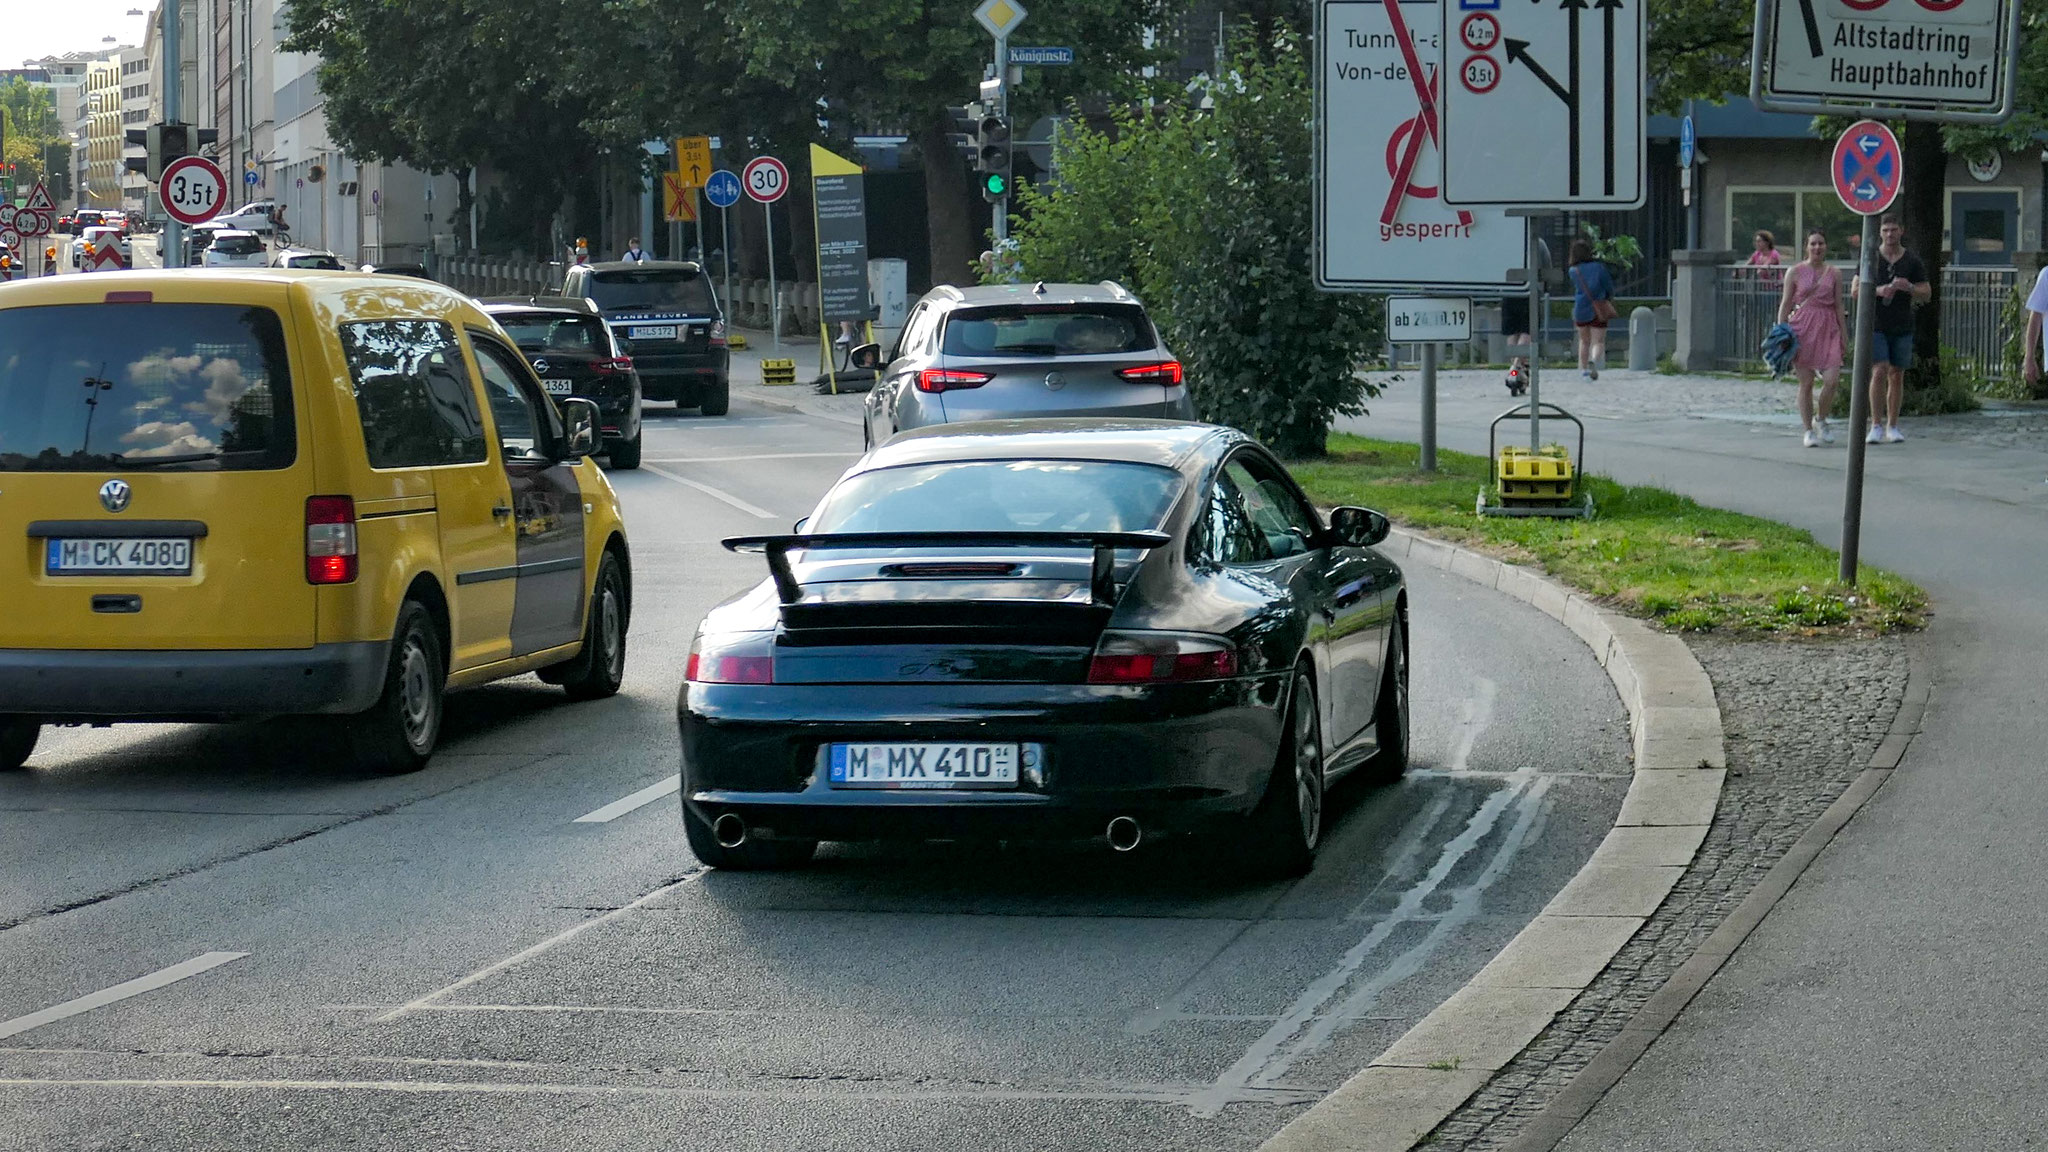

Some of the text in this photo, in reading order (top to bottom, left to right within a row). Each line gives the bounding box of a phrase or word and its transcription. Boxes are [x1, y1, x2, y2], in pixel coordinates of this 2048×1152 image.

[1833, 22, 1970, 60] Altstadtring
[1010, 49, 1070, 64] Königinstr.
[1830, 57, 1988, 91] Hauptbahnhof
[753, 169, 778, 190] 30
[1380, 222, 1471, 242] gesperrt
[1395, 312, 1410, 327] ab
[64, 542, 187, 566] M CK 4080
[850, 747, 992, 777] M MX 410
